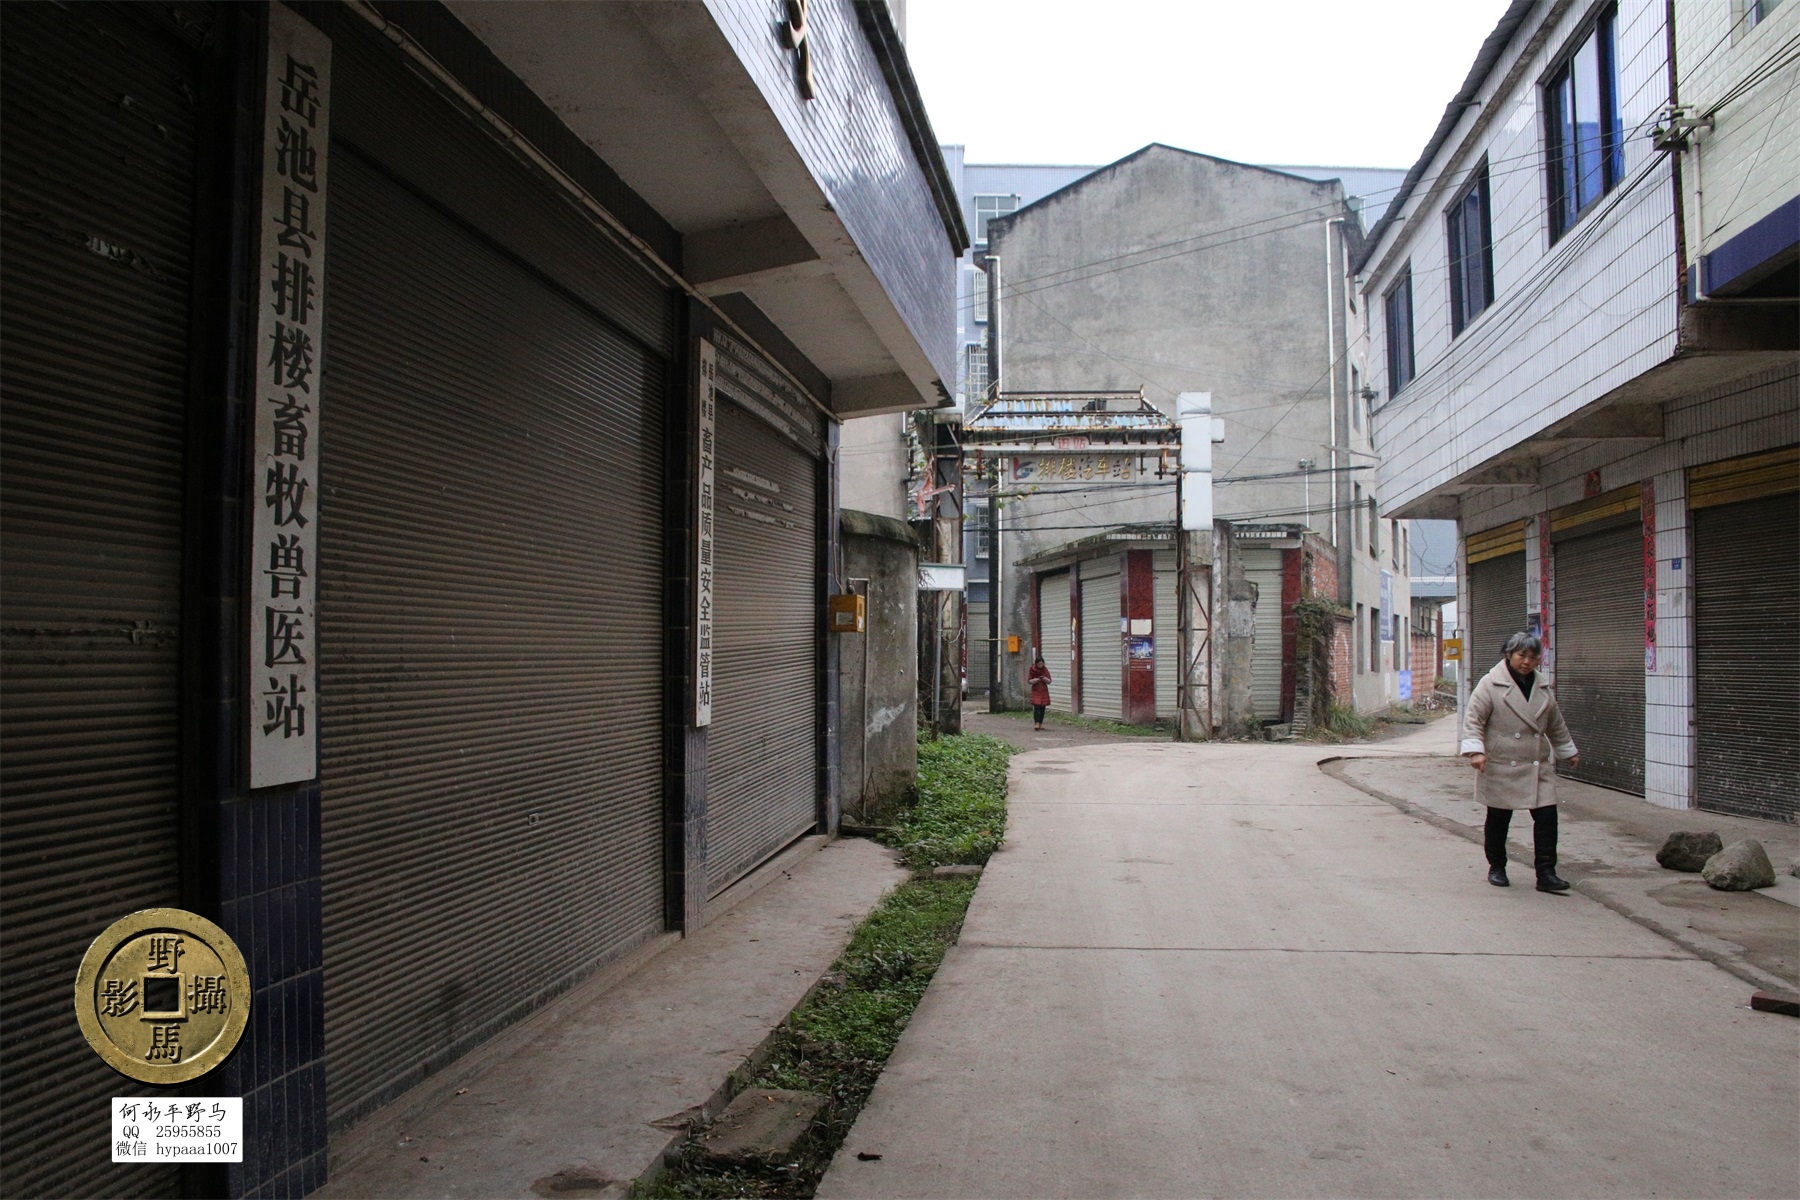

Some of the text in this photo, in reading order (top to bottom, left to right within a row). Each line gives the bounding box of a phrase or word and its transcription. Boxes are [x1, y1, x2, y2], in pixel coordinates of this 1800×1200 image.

[263, 53, 321, 739] 岳池县排楼畜牧兽医站
[699, 426, 713, 706] 畜产品质量安全监管站
